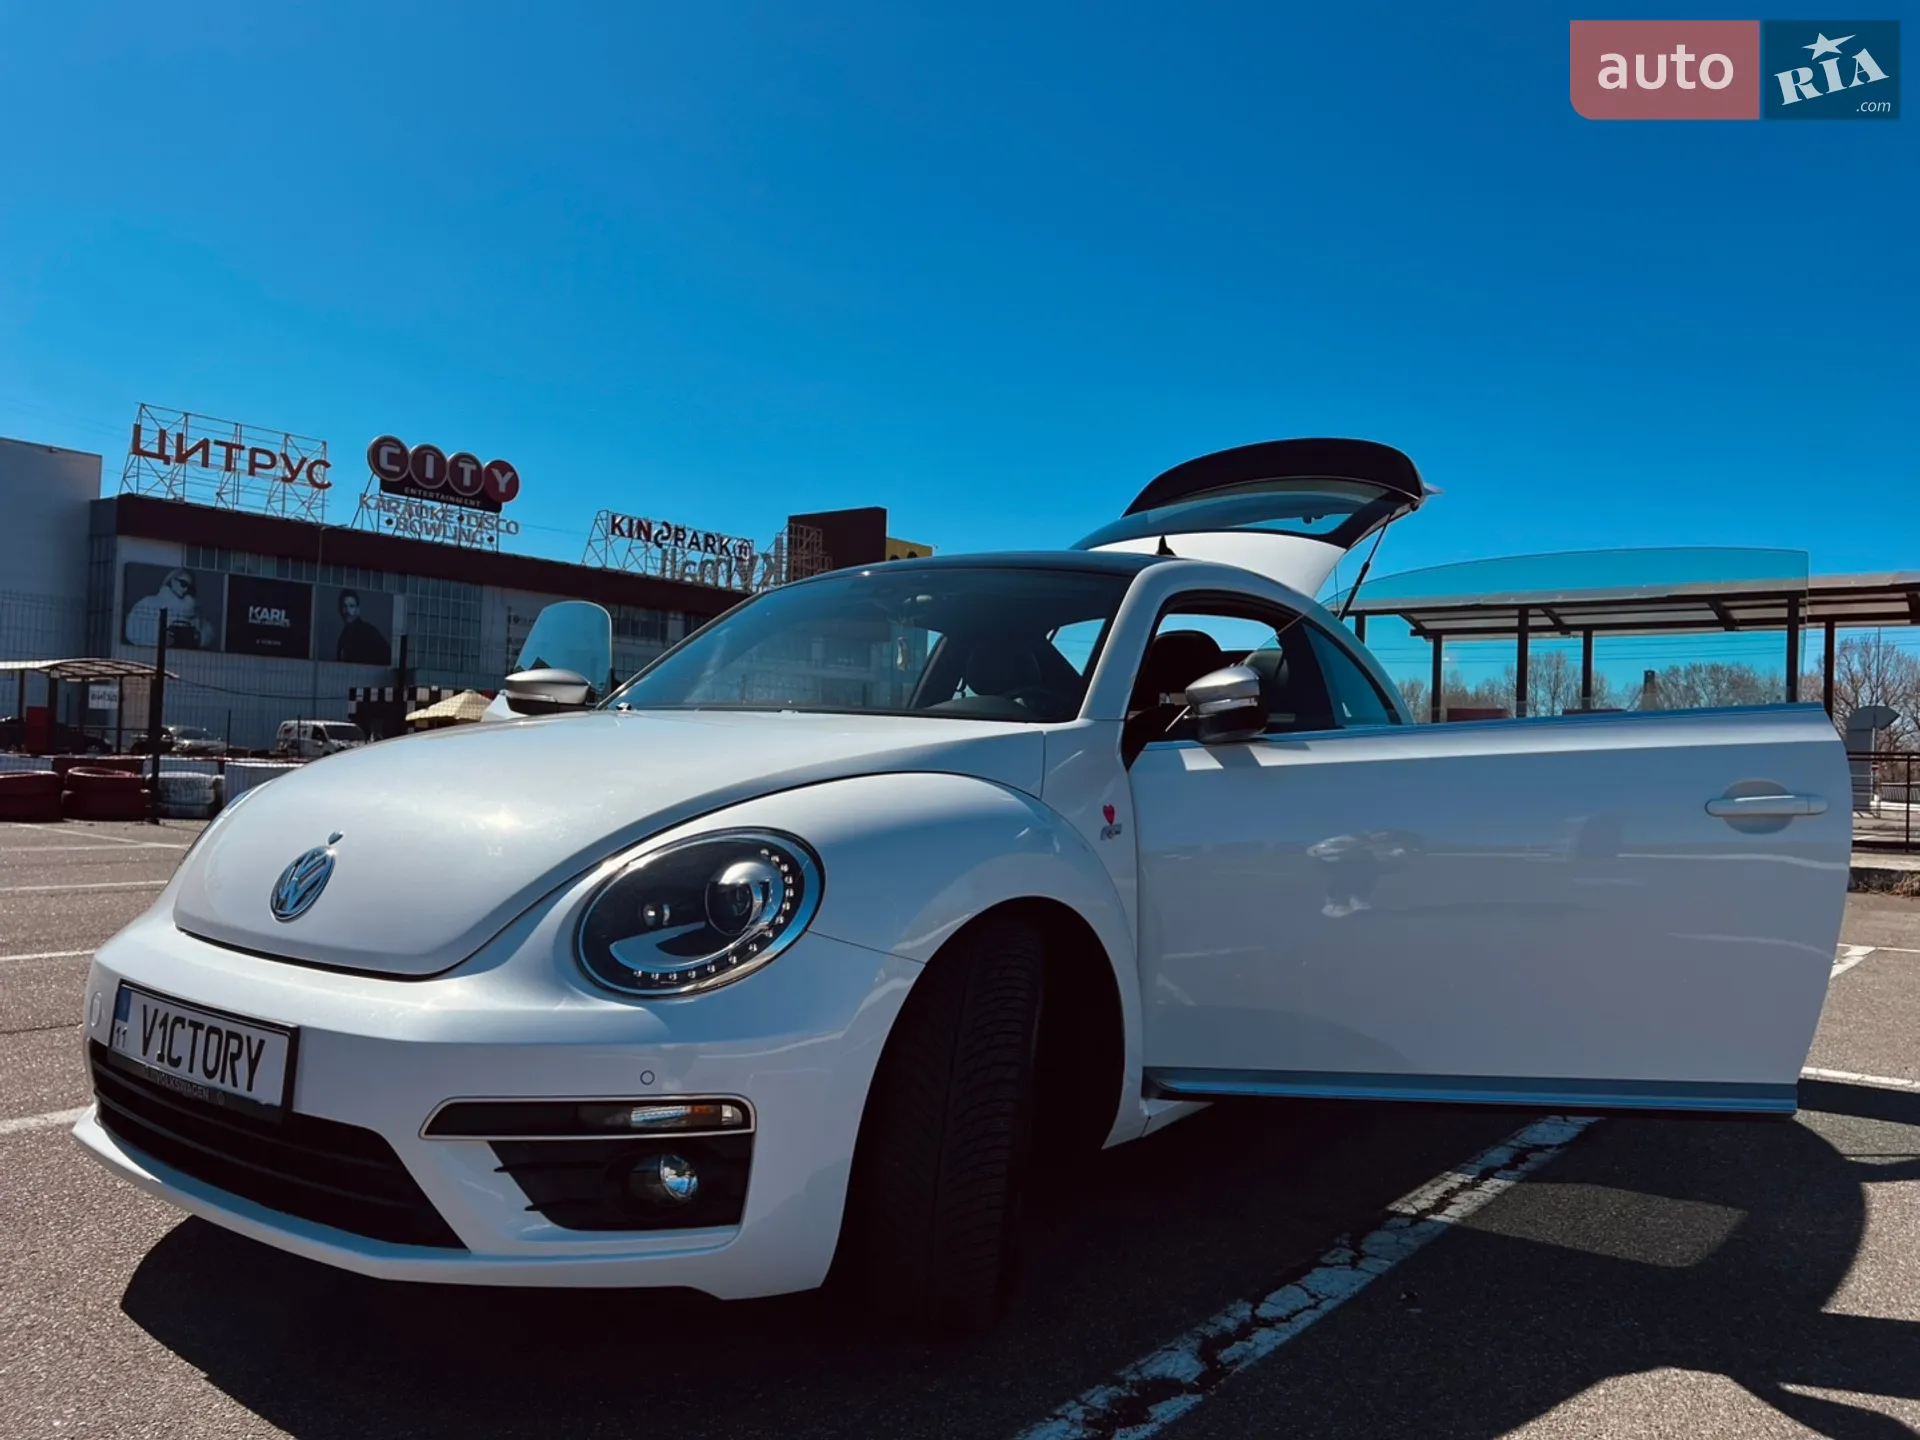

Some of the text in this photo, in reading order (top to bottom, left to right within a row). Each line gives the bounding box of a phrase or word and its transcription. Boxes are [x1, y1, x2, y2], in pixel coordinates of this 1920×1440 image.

[132, 423, 333, 490] ЦИТРУС
[376, 440, 517, 494] CITY
[404, 486, 481, 507] ENTERTAINMENT
[249, 606, 288, 622] KARL
[142, 1004, 266, 1092] V1CTORY
